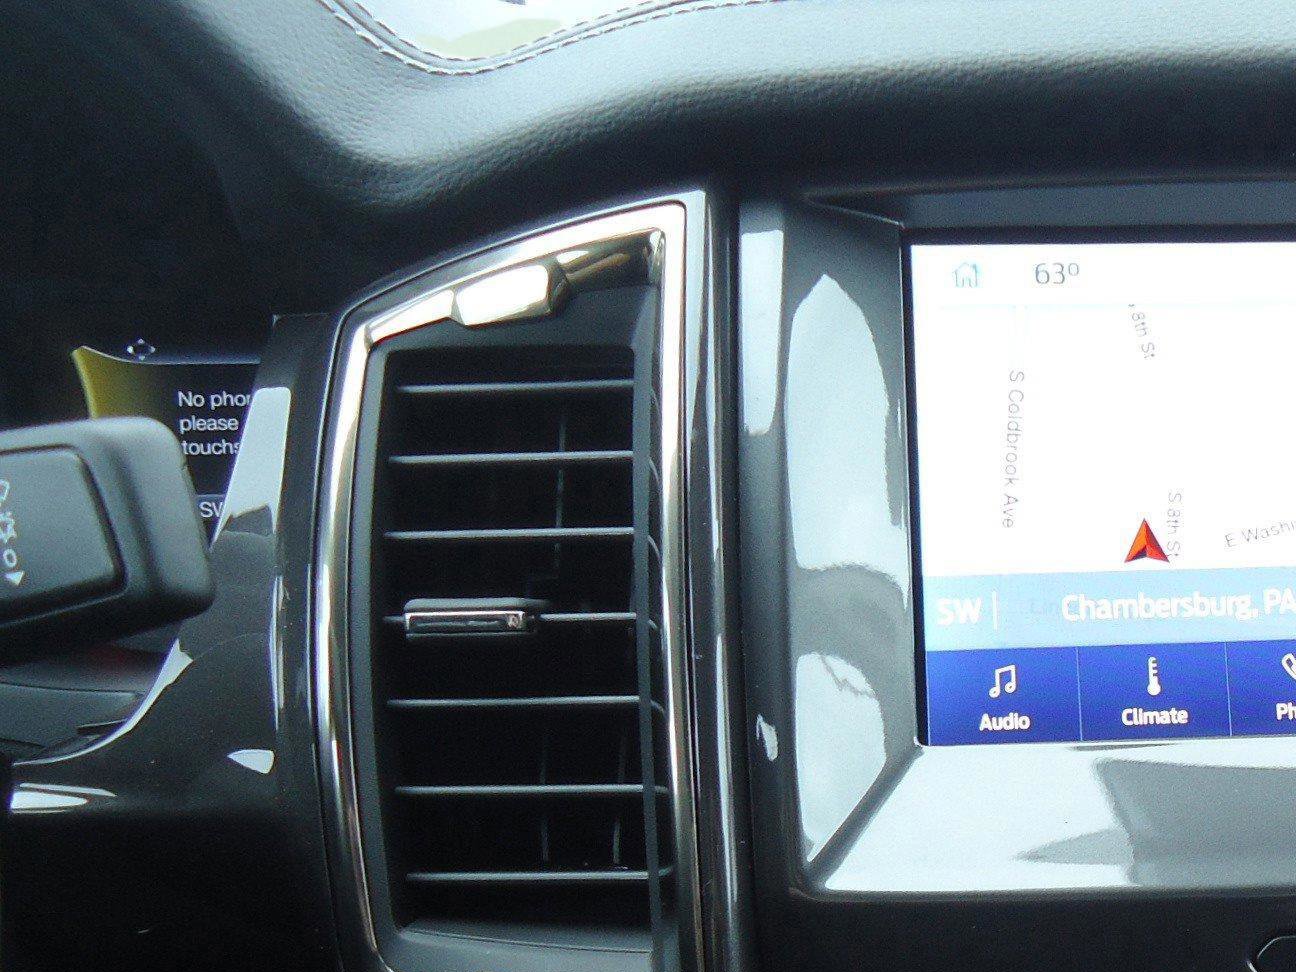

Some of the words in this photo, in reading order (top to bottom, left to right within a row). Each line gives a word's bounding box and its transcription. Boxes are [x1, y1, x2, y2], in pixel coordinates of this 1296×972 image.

[177, 390, 205, 408] No
[180, 415, 240, 434] please
[1004, 388, 1024, 488] Coldbrook
[1001, 492, 1019, 530] Ave
[937, 598, 982, 626] SW
[1061, 591, 1259, 621] Chambersburg,
[979, 711, 1031, 733] Audio
[1121, 706, 1189, 728] Climate
